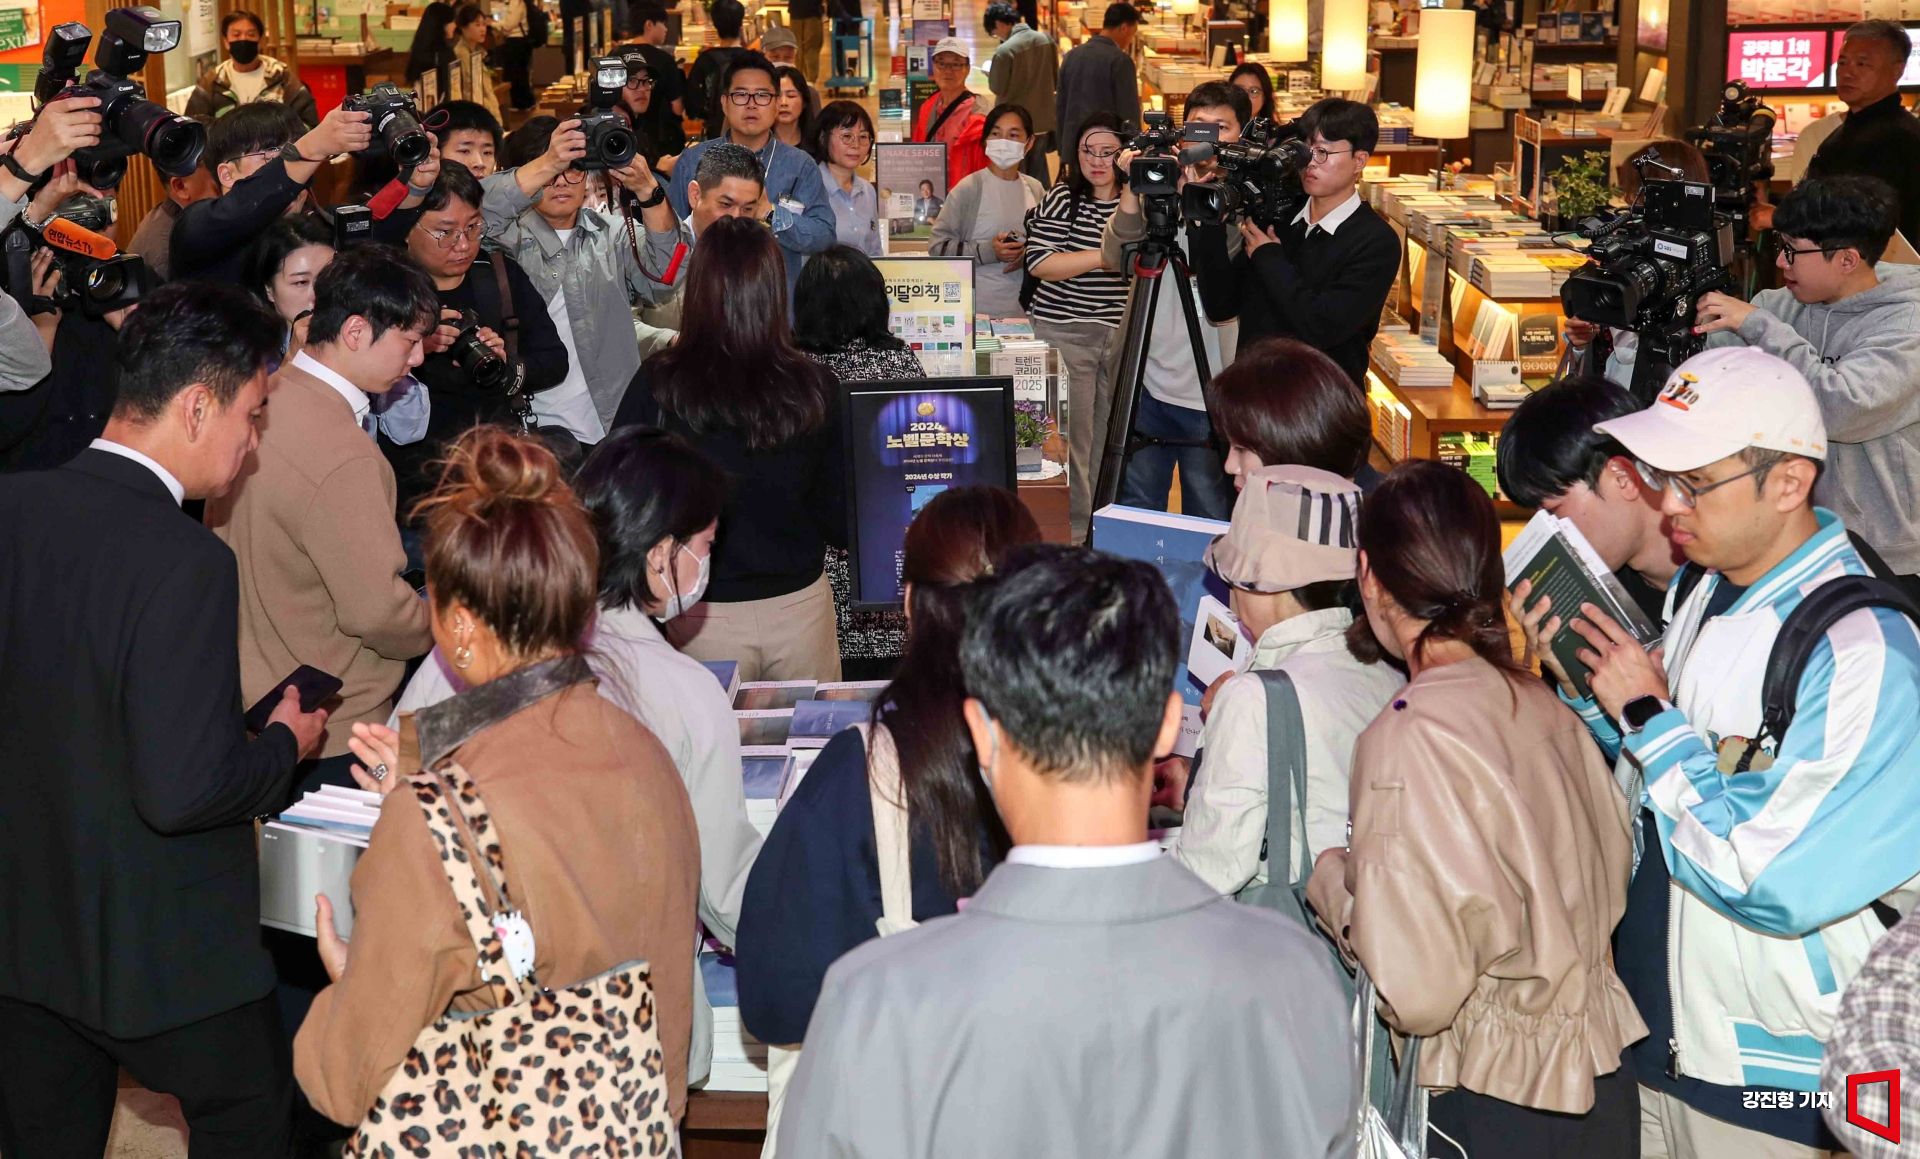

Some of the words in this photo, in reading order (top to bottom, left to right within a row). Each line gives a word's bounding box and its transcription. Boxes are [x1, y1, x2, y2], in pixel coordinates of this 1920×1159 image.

[1742, 39, 1784, 56] 공무원
[1786, 36, 1811, 55] 1위
[1741, 57, 1812, 82] 박문각
[911, 148, 941, 157] SENSE
[48, 228, 94, 256] 연합뉴스TV
[1014, 355, 1042, 366] 트렌드
[1015, 367, 1042, 379] 코리아
[1014, 379, 1042, 391] 2025
[910, 422, 943, 432] 2024
[886, 432, 970, 449] 노벨문학상
[940, 472, 953, 480] 작가
